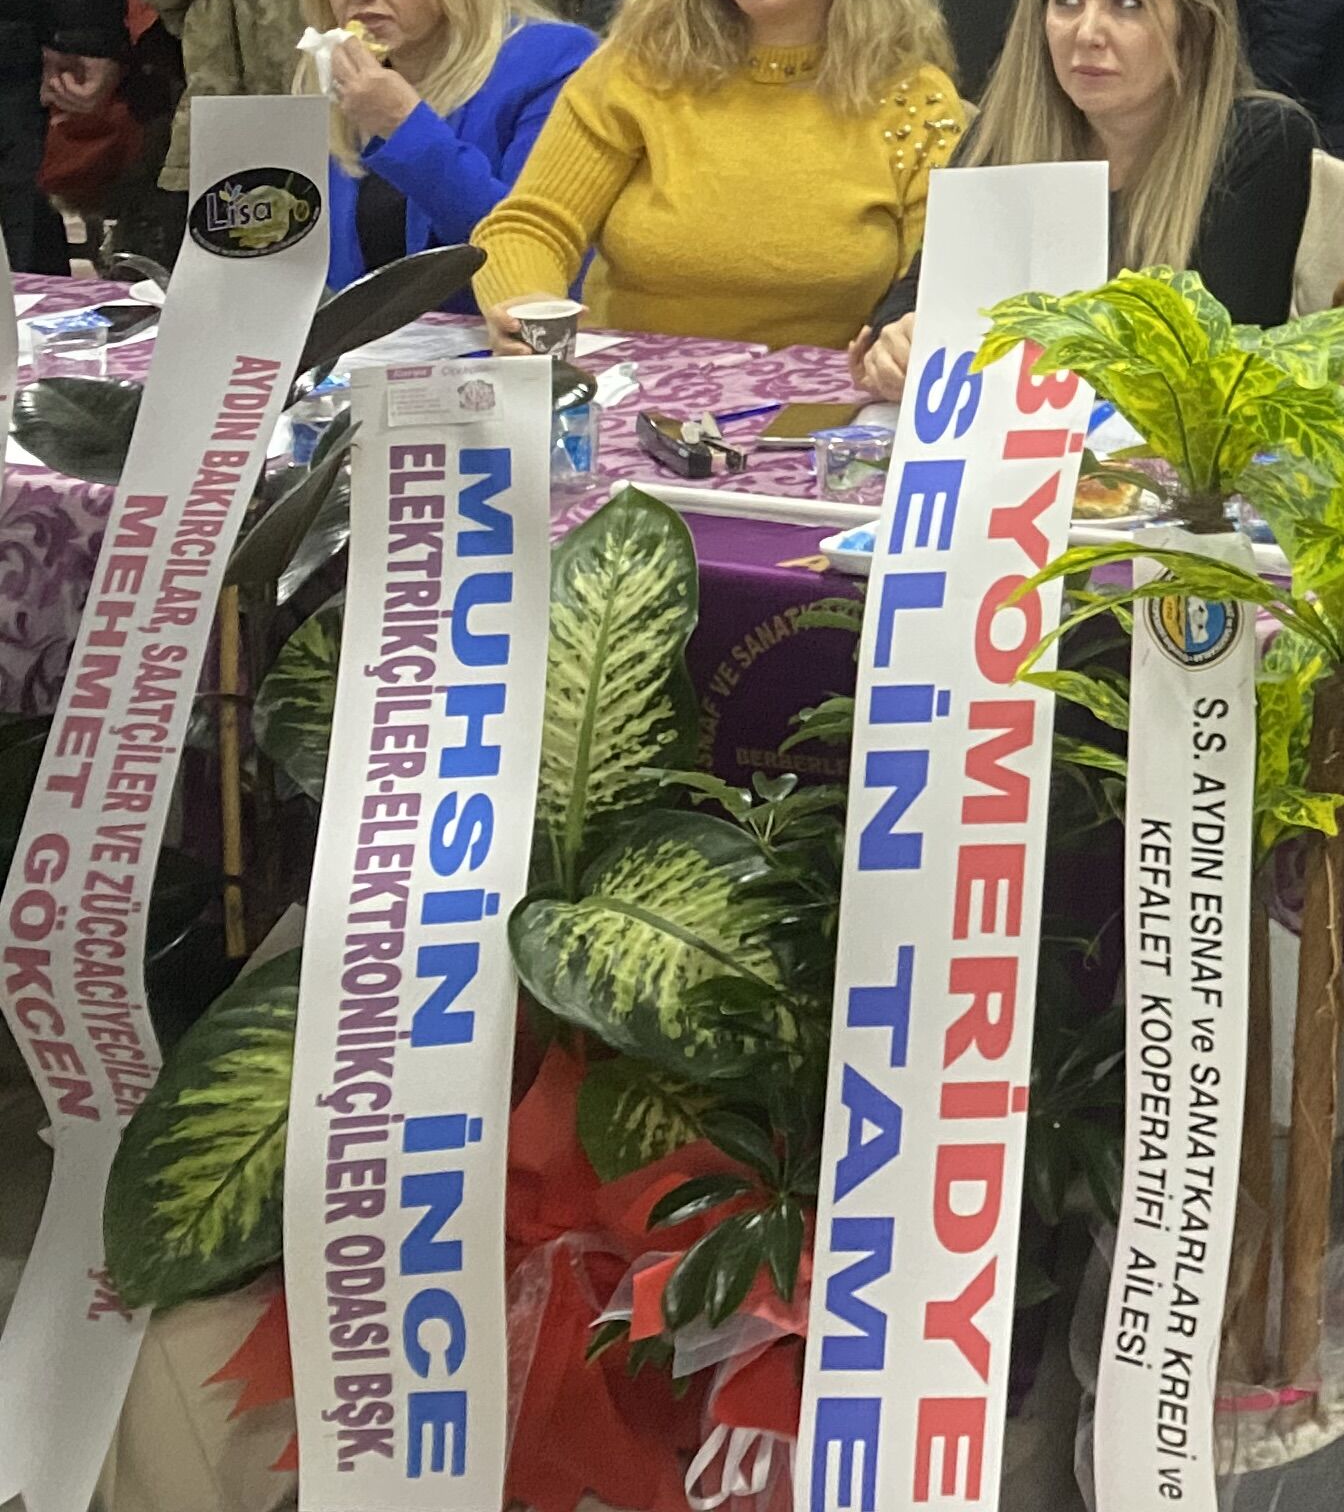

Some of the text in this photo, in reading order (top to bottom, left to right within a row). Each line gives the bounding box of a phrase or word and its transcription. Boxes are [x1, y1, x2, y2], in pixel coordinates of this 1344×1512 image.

[206, 191, 272, 232] Lisa
[211, 354, 282, 441] AYDIN
[46, 494, 169, 809] MEHMET
[102, 643, 189, 813] SAATÇİLER
[410, 447, 513, 1048] MUHSİN
[90, 823, 147, 865] VE
[810, 346, 983, 1512] SELİN TAME
[1115, 817, 1175, 1368] KEFALET KOOPERATİFİ AİLESİ
[1157, 697, 1229, 1500] S.S. AYDIN ESNAF ve SANATKARLAR KREDİ ve
[324, 1235, 390, 1363] ODASI
[400, 1113, 483, 1479] İNCE
[320, 1370, 394, 1473] BŞK.
